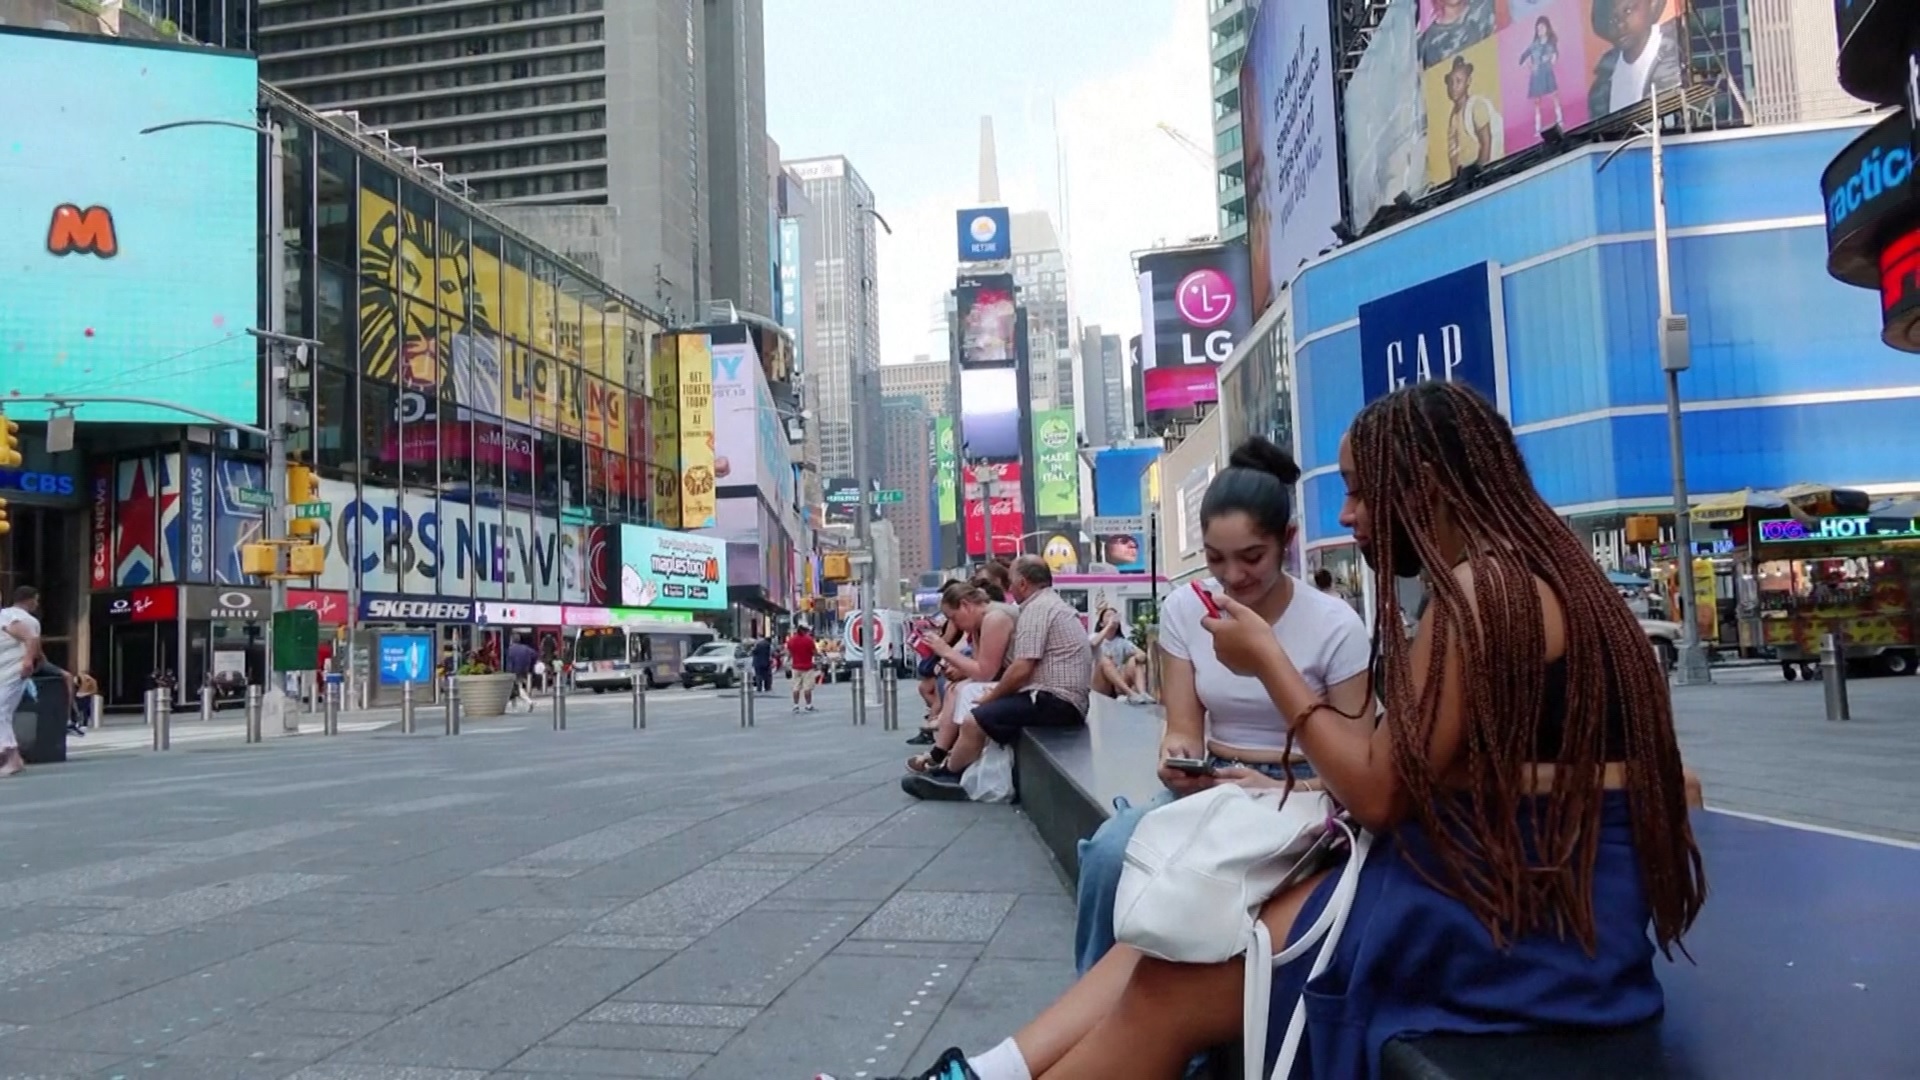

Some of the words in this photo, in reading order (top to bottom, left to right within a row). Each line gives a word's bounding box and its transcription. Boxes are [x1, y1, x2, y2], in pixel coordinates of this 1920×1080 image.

[47, 203, 117, 258] M
[781, 229, 796, 316] TIMES
[1182, 329, 1234, 365] LG
[1387, 323, 1462, 394] GAP
[1041, 452, 1072, 464] MADE
[1050, 462, 1062, 472] IN
[20, 472, 74, 496] CBS
[191, 466, 204, 520] NEWS
[1042, 471, 1071, 483] ITALY
[308, 504, 320, 517] 44
[94, 531, 105, 566] CBS
[191, 522, 204, 558] CBS
[337, 500, 445, 578] CBS
[456, 518, 577, 589] NEWS
[211, 608, 259, 618] OAKLEY
[368, 599, 471, 619] SKECHERS
